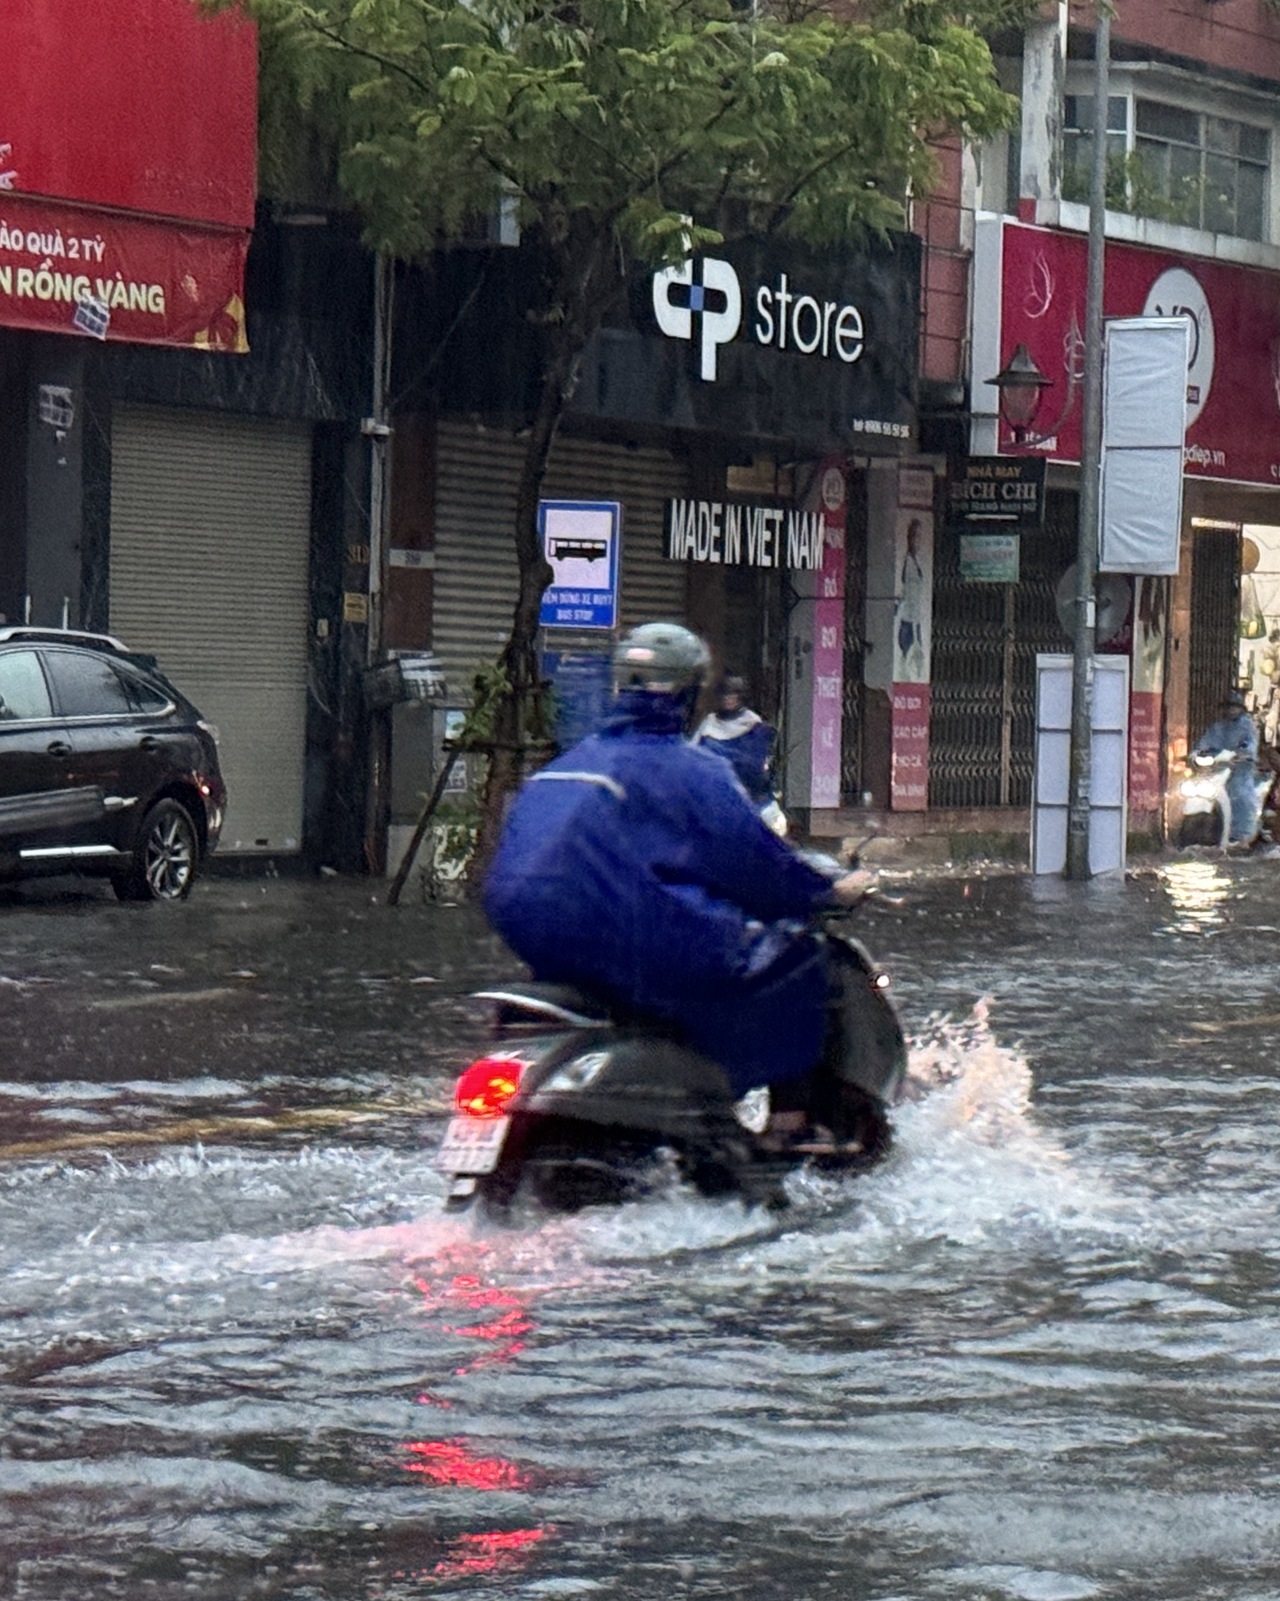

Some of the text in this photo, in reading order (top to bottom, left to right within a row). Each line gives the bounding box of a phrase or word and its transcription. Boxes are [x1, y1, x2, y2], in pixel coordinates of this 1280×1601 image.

[27, 229, 66, 258] QUÀ
[67, 237, 80, 259] 2
[17, 257, 92, 304] RỒNG
[96, 271, 166, 315] VÀNG
[756, 273, 865, 363] store
[1001, 481, 1038, 500] CHI
[670, 498, 825, 571] MADE IN VIET NAM
